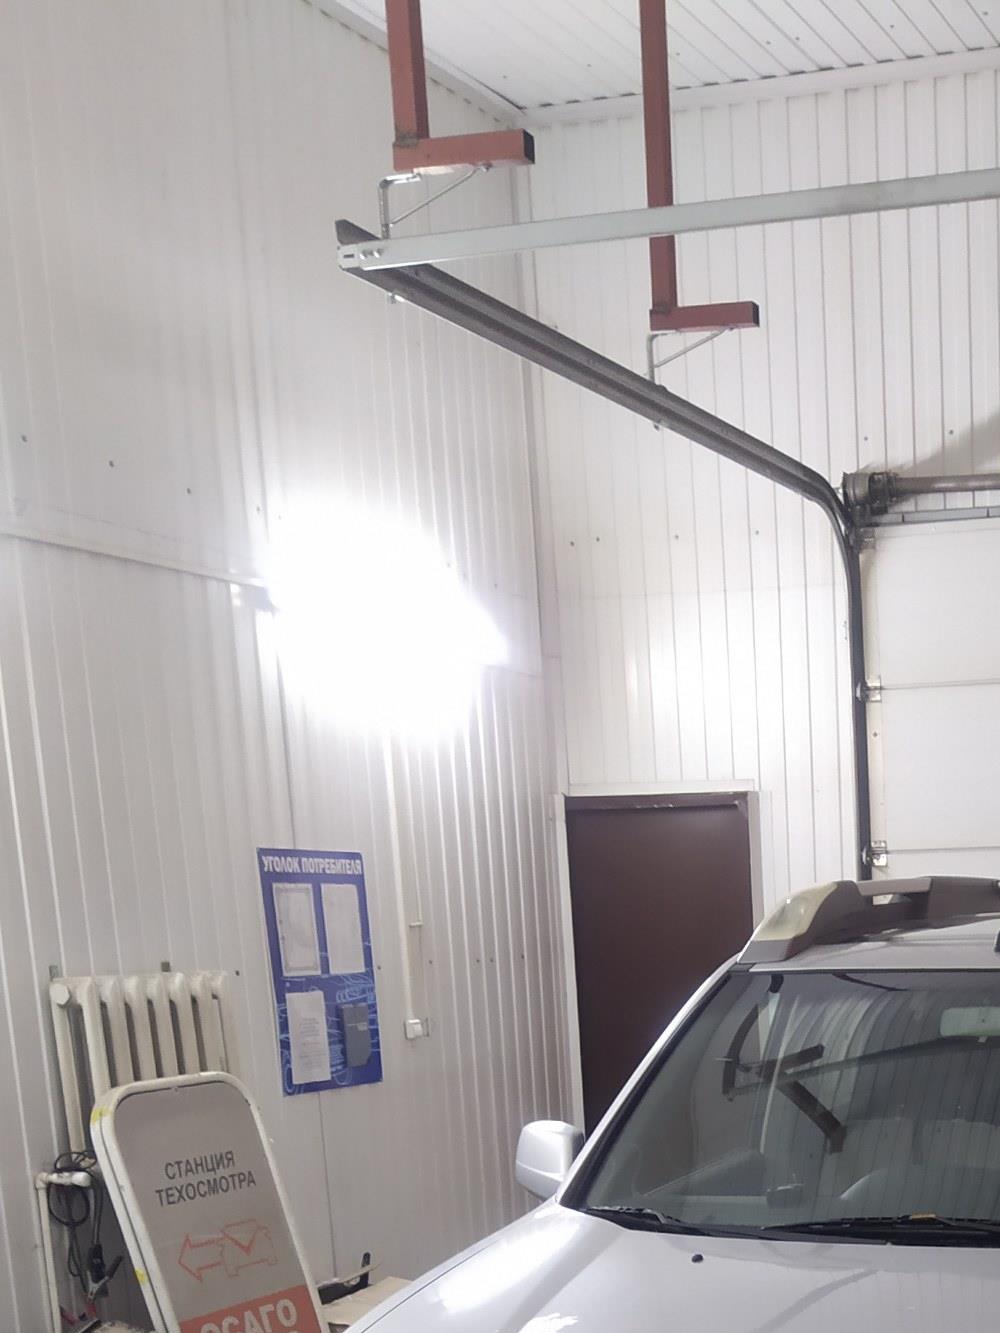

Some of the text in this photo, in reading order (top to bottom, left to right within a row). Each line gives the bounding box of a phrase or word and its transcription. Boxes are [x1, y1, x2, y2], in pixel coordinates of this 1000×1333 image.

[261, 855, 363, 875] УГОЛОК ПОТРЕБИТЕЛЯ
[164, 1150, 236, 1180] СТАНЦИЯ
[155, 1170, 257, 1207] ТЕХОСМОТРА
